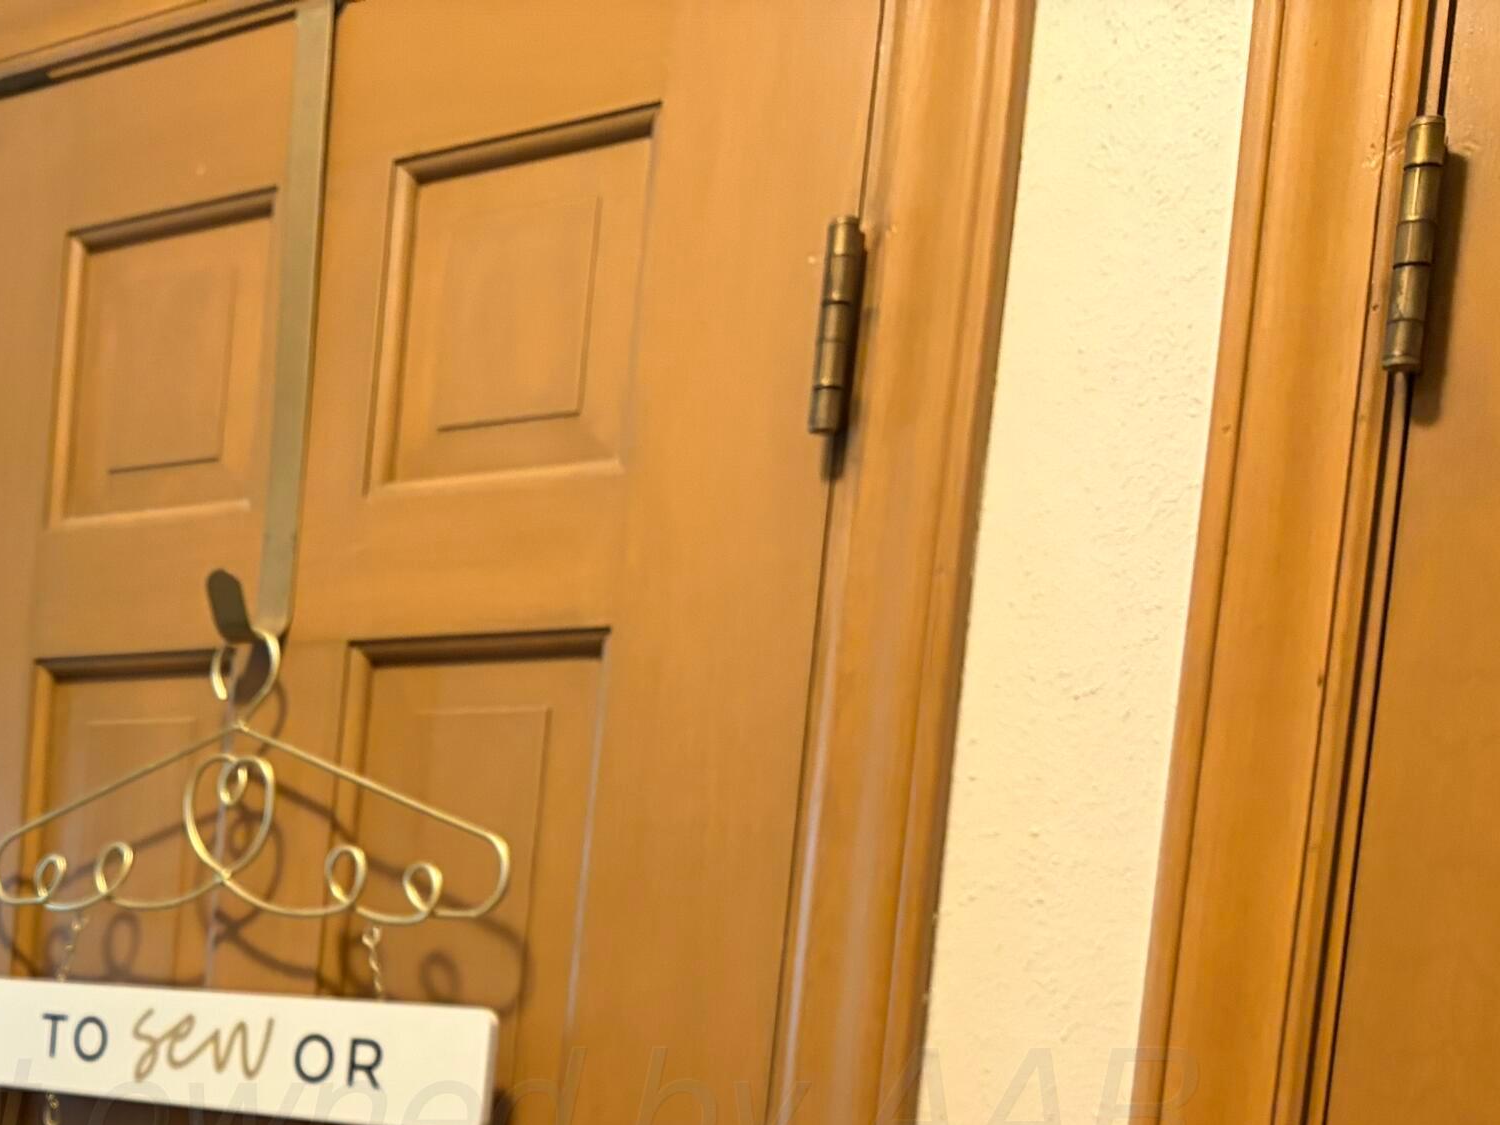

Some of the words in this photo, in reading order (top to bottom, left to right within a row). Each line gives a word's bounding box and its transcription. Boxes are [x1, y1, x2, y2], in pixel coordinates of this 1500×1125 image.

[42, 1013, 108, 1062] TO
[132, 1008, 274, 1083] sew
[294, 1033, 384, 1089] OR
